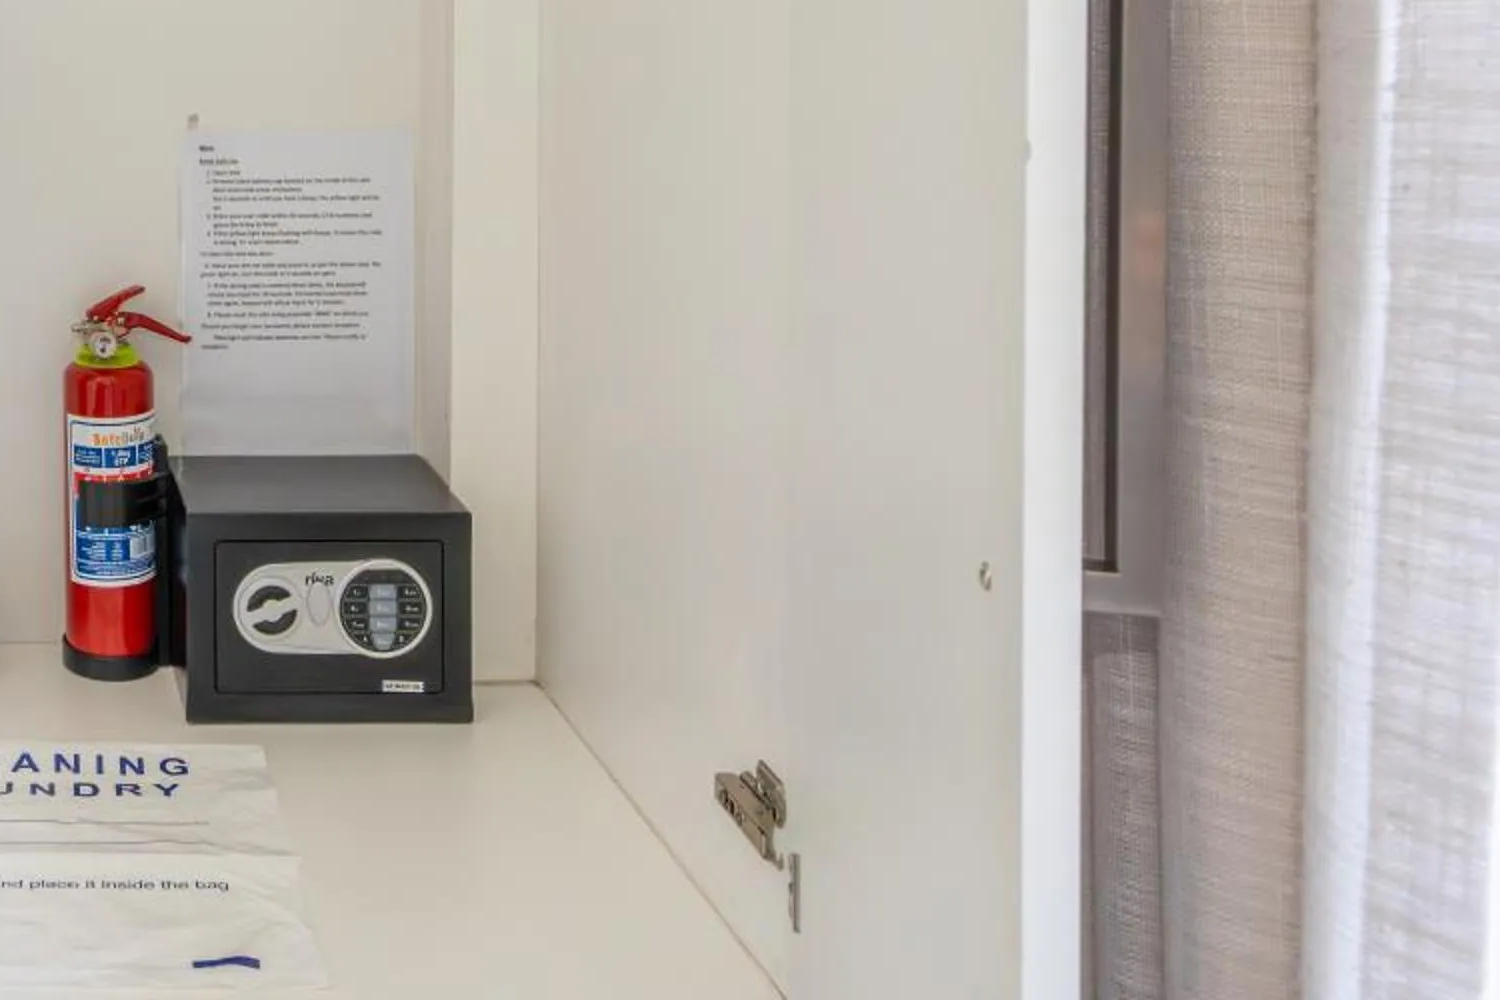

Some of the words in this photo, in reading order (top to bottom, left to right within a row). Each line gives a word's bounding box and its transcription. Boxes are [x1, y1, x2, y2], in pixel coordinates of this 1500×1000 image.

[29, 879, 80, 892] place
[85, 879, 96, 890] it
[101, 879, 156, 891] inside
[160, 879, 190, 891] the
[195, 879, 230, 893] bag
